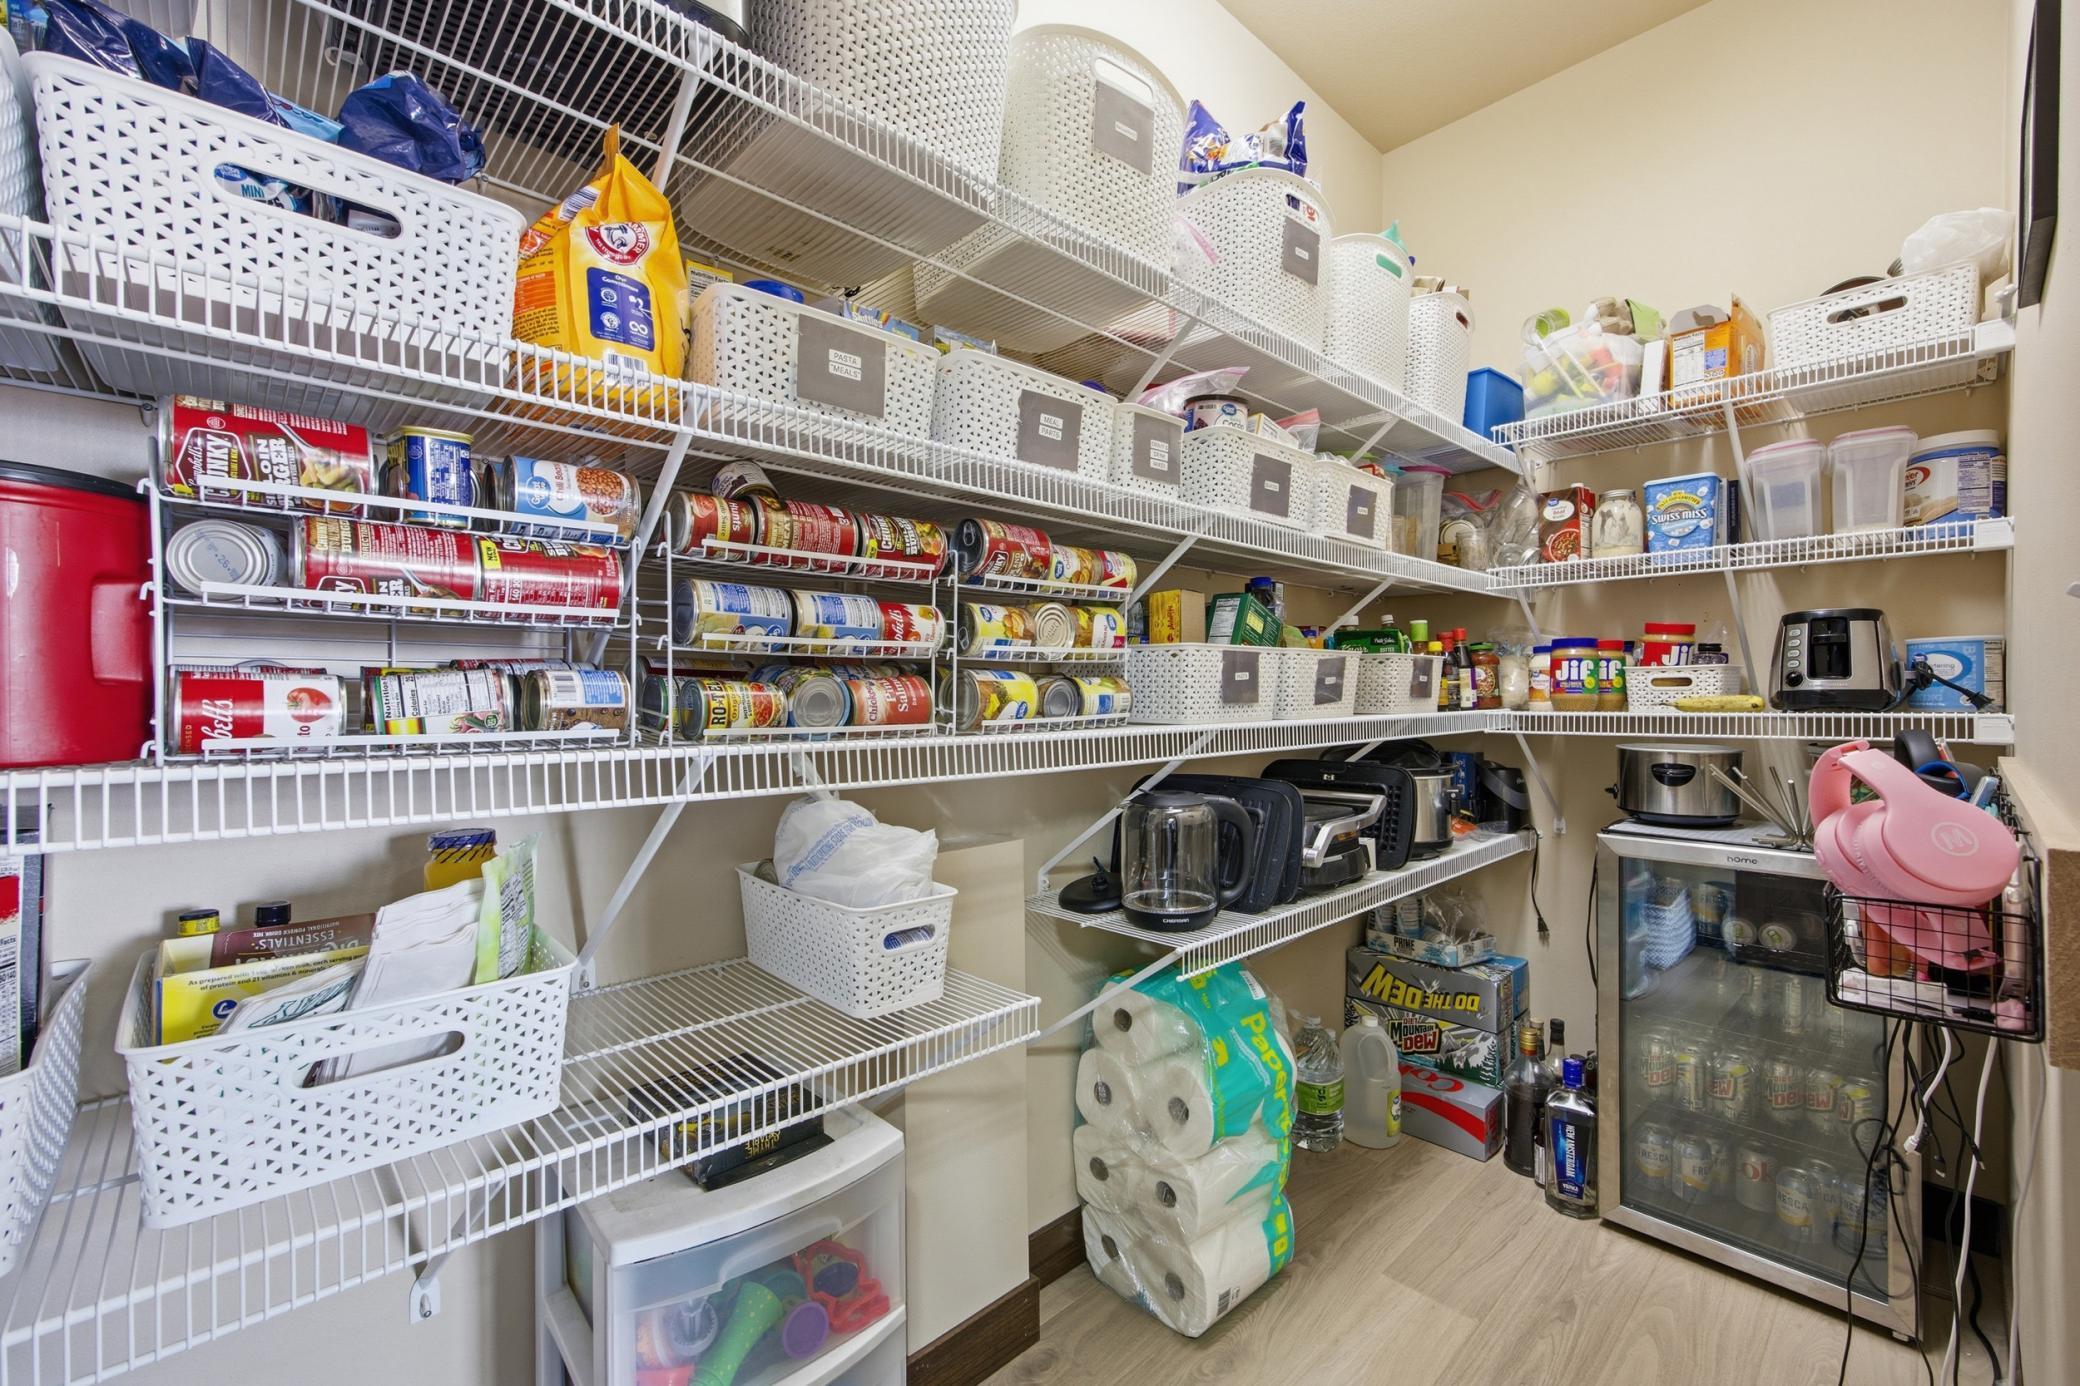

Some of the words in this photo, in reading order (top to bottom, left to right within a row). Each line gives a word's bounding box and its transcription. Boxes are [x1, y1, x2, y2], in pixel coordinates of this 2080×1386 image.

[241, 184, 265, 198] MINI
[834, 352, 857, 365] PASTA
[830, 363, 861, 379] "MEALS"
[1043, 416, 1060, 427] MEAL
[1041, 427, 1060, 439] PARTS
[203, 434, 232, 498] CUNKY
[1662, 642, 1696, 666] Ji
[1555, 659, 1594, 681] Jif
[1600, 659, 1622, 681] if
[384, 679, 394, 719] Nutrition
[411, 689, 419, 716] Calories
[283, 925, 306, 934] POWDER
[255, 930, 334, 949] ESSENTIALS
[1394, 937, 1416, 951] PRIME
[199, 975, 233, 985] prepared
[313, 959, 328, 967] each
[328, 956, 352, 966] serving
[209, 980, 236, 991] protein
[261, 972, 291, 982] vitamins
[1360, 962, 1423, 1010] DEW
[1424, 991, 1451, 1010] THE
[1454, 995, 1481, 1012] DO
[1403, 1017, 1419, 1025] DIET
[1240, 1011, 1288, 1100] Paper
[1566, 1124, 1576, 1139] NEW
[1565, 1139, 1576, 1178] AMSTERDAM
